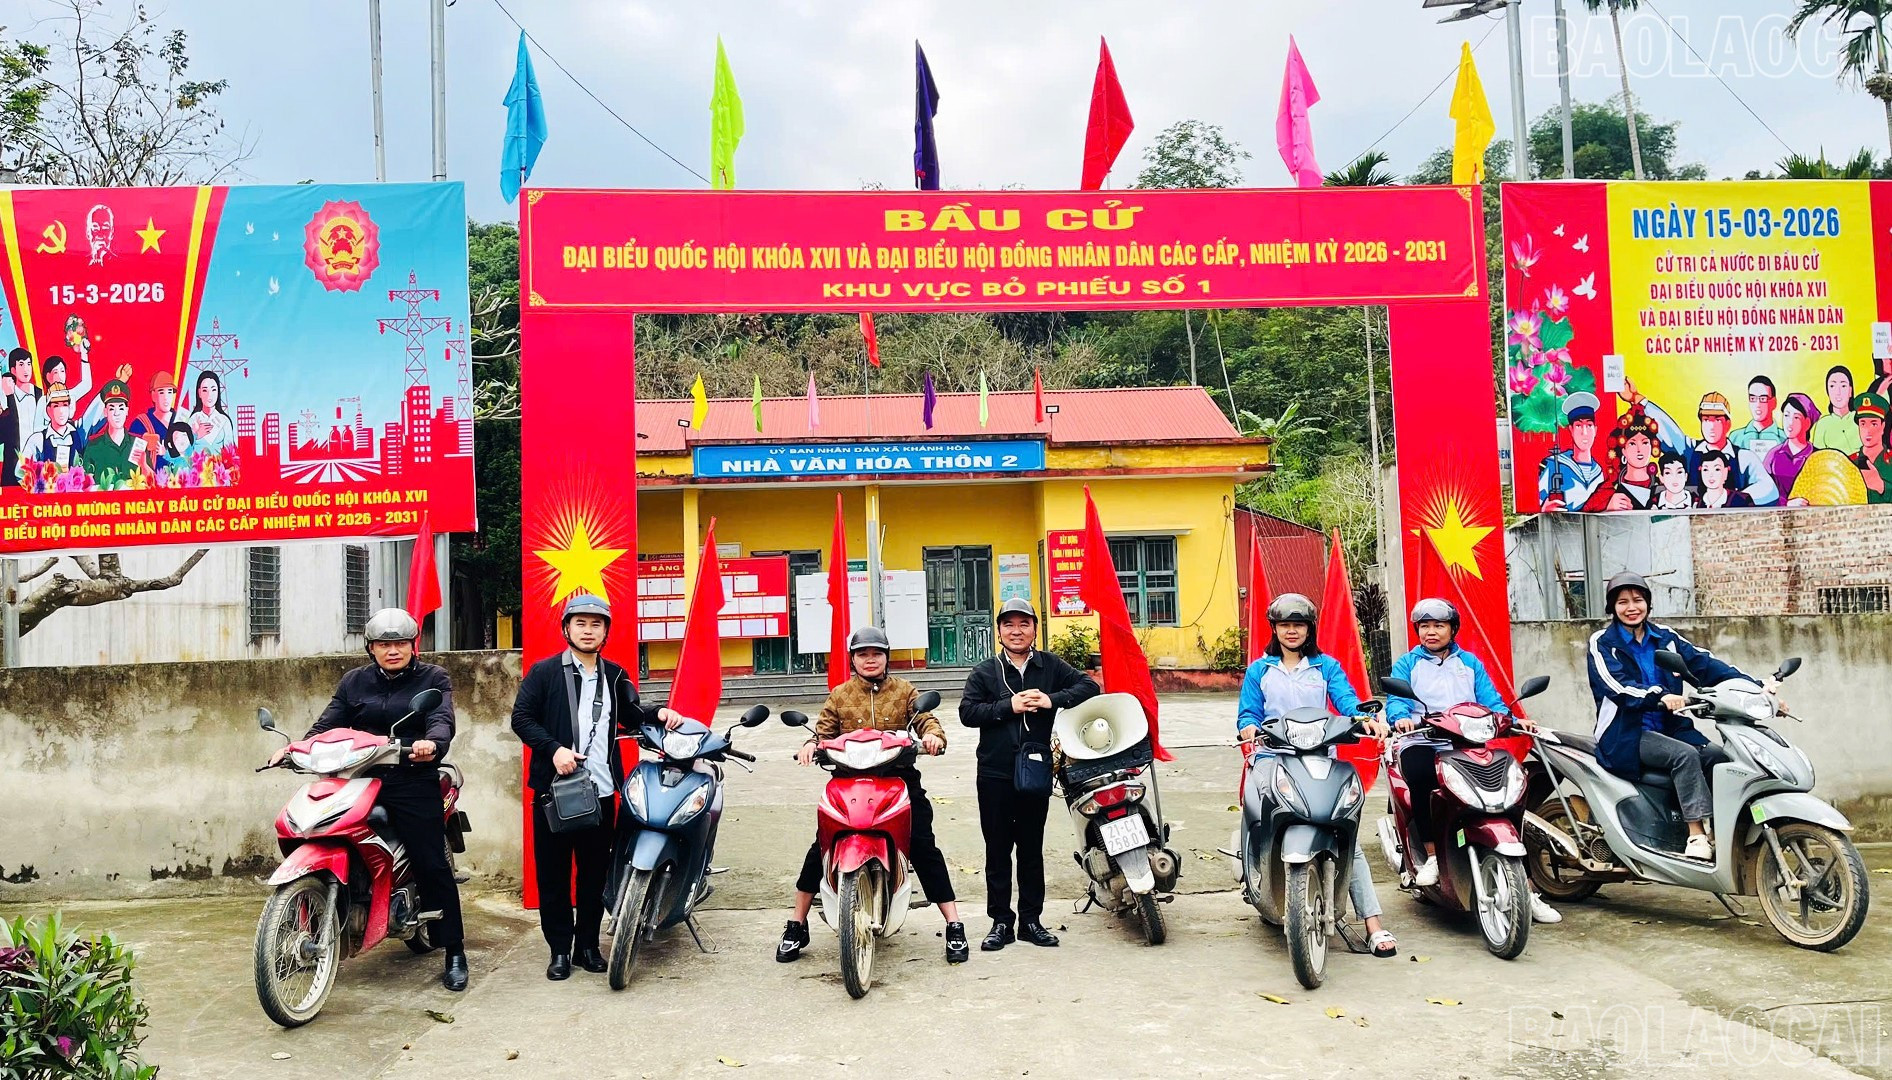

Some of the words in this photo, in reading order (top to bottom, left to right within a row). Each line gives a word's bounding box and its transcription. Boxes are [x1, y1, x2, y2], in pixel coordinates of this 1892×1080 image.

[885, 202, 1020, 231] BẦU
[1046, 200, 1143, 230] CỬ
[1633, 203, 1696, 238] NGÀY
[1705, 208, 1839, 238] 15-03-2026
[563, 246, 596, 272] ĐẠI
[603, 238, 648, 268] BIỂU
[655, 240, 707, 271] QUỐC
[713, 243, 746, 273] HỘI
[752, 243, 805, 269] KHÓA
[810, 247, 841, 268] XVI
[846, 243, 872, 268] VÀ
[876, 247, 909, 273] ĐẠI
[914, 238, 958, 268] BIỂU
[963, 242, 995, 272] HỘI
[1000, 240, 1052, 268] ĐỒNG
[1057, 242, 1110, 267] NHÂN
[1115, 241, 1154, 266] DÂN
[1160, 240, 1196, 266] CÁC
[1202, 237, 1245, 267] CẤP,
[1250, 239, 1310, 268] NHIỆM
[1315, 238, 1338, 263] KỲ
[1344, 242, 1387, 262] 2026
[1405, 241, 1446, 261] 2031
[1657, 251, 1673, 272] CỬ
[1677, 257, 1696, 272] TRI
[1701, 251, 1716, 272] CẢ
[1721, 253, 1754, 271] NƯỚC
[1758, 256, 1770, 271] ĐI
[1775, 252, 1798, 270] BẦU
[1803, 249, 1819, 270] CỬ
[50, 283, 164, 304] 15-3-2026
[823, 283, 891, 297] KHU
[902, 281, 971, 301] VỰC
[982, 276, 1026, 296] BỎ
[1037, 276, 1130, 295] PHIẾU
[1142, 274, 1185, 294] SỐ
[1198, 280, 1210, 293] 1
[1650, 284, 1671, 303] ĐẠI
[1676, 278, 1704, 299] BIỂU
[1709, 278, 1741, 300] QUỐC
[1746, 280, 1766, 301] HỘI
[1771, 279, 1803, 297] KHÓA
[1807, 282, 1826, 297] XVI
[1640, 308, 1655, 326] VÀ
[1660, 311, 1680, 330] ĐẠI
[1685, 304, 1713, 326] BIỂU
[1718, 307, 1738, 329] HỘI
[1742, 304, 1776, 325] ĐỒNG
[1780, 306, 1814, 324] NHÂN
[1818, 305, 1843, 323] DÂN
[1647, 335, 1670, 353] CÁC
[1676, 332, 1699, 353] CẤP
[1704, 334, 1745, 356] NHIỆM
[1750, 333, 1764, 351] KỲ
[1769, 336, 1798, 351] 2026
[1811, 336, 1838, 350] 2031
[722, 458, 781, 472] NHÀ
[790, 457, 846, 471] VĂN
[856, 456, 912, 470] HÓA
[920, 454, 992, 468] THÔN
[1002, 456, 1017, 466] 2
[33, 502, 72, 518] CHÀO
[76, 501, 120, 516] MỪNG
[125, 499, 164, 514] NGÀY
[169, 496, 198, 512] BẦU
[203, 495, 224, 511] CỬ
[226, 497, 250, 512] ĐẠI
[256, 491, 288, 509] BIỂU
[293, 490, 330, 508] QUỐC
[335, 490, 358, 507] HỘI
[363, 489, 401, 504] KHÓA
[405, 490, 427, 502] XVI
[4, 522, 37, 540] BIỂU
[42, 523, 65, 540] HỘI
[70, 521, 110, 537] ĐỒNG
[115, 520, 156, 535] NHÂN
[161, 518, 191, 533] DÂN
[196, 517, 225, 532] CÁC
[230, 513, 258, 530] CẤP
[263, 514, 310, 530] NHIỆM
[315, 512, 332, 527] KỲ
[337, 513, 371, 526] 2026
[386, 511, 417, 523] 2031
[651, 563, 680, 572] BẢNG
[1108, 830, 1147, 853] 258.01
